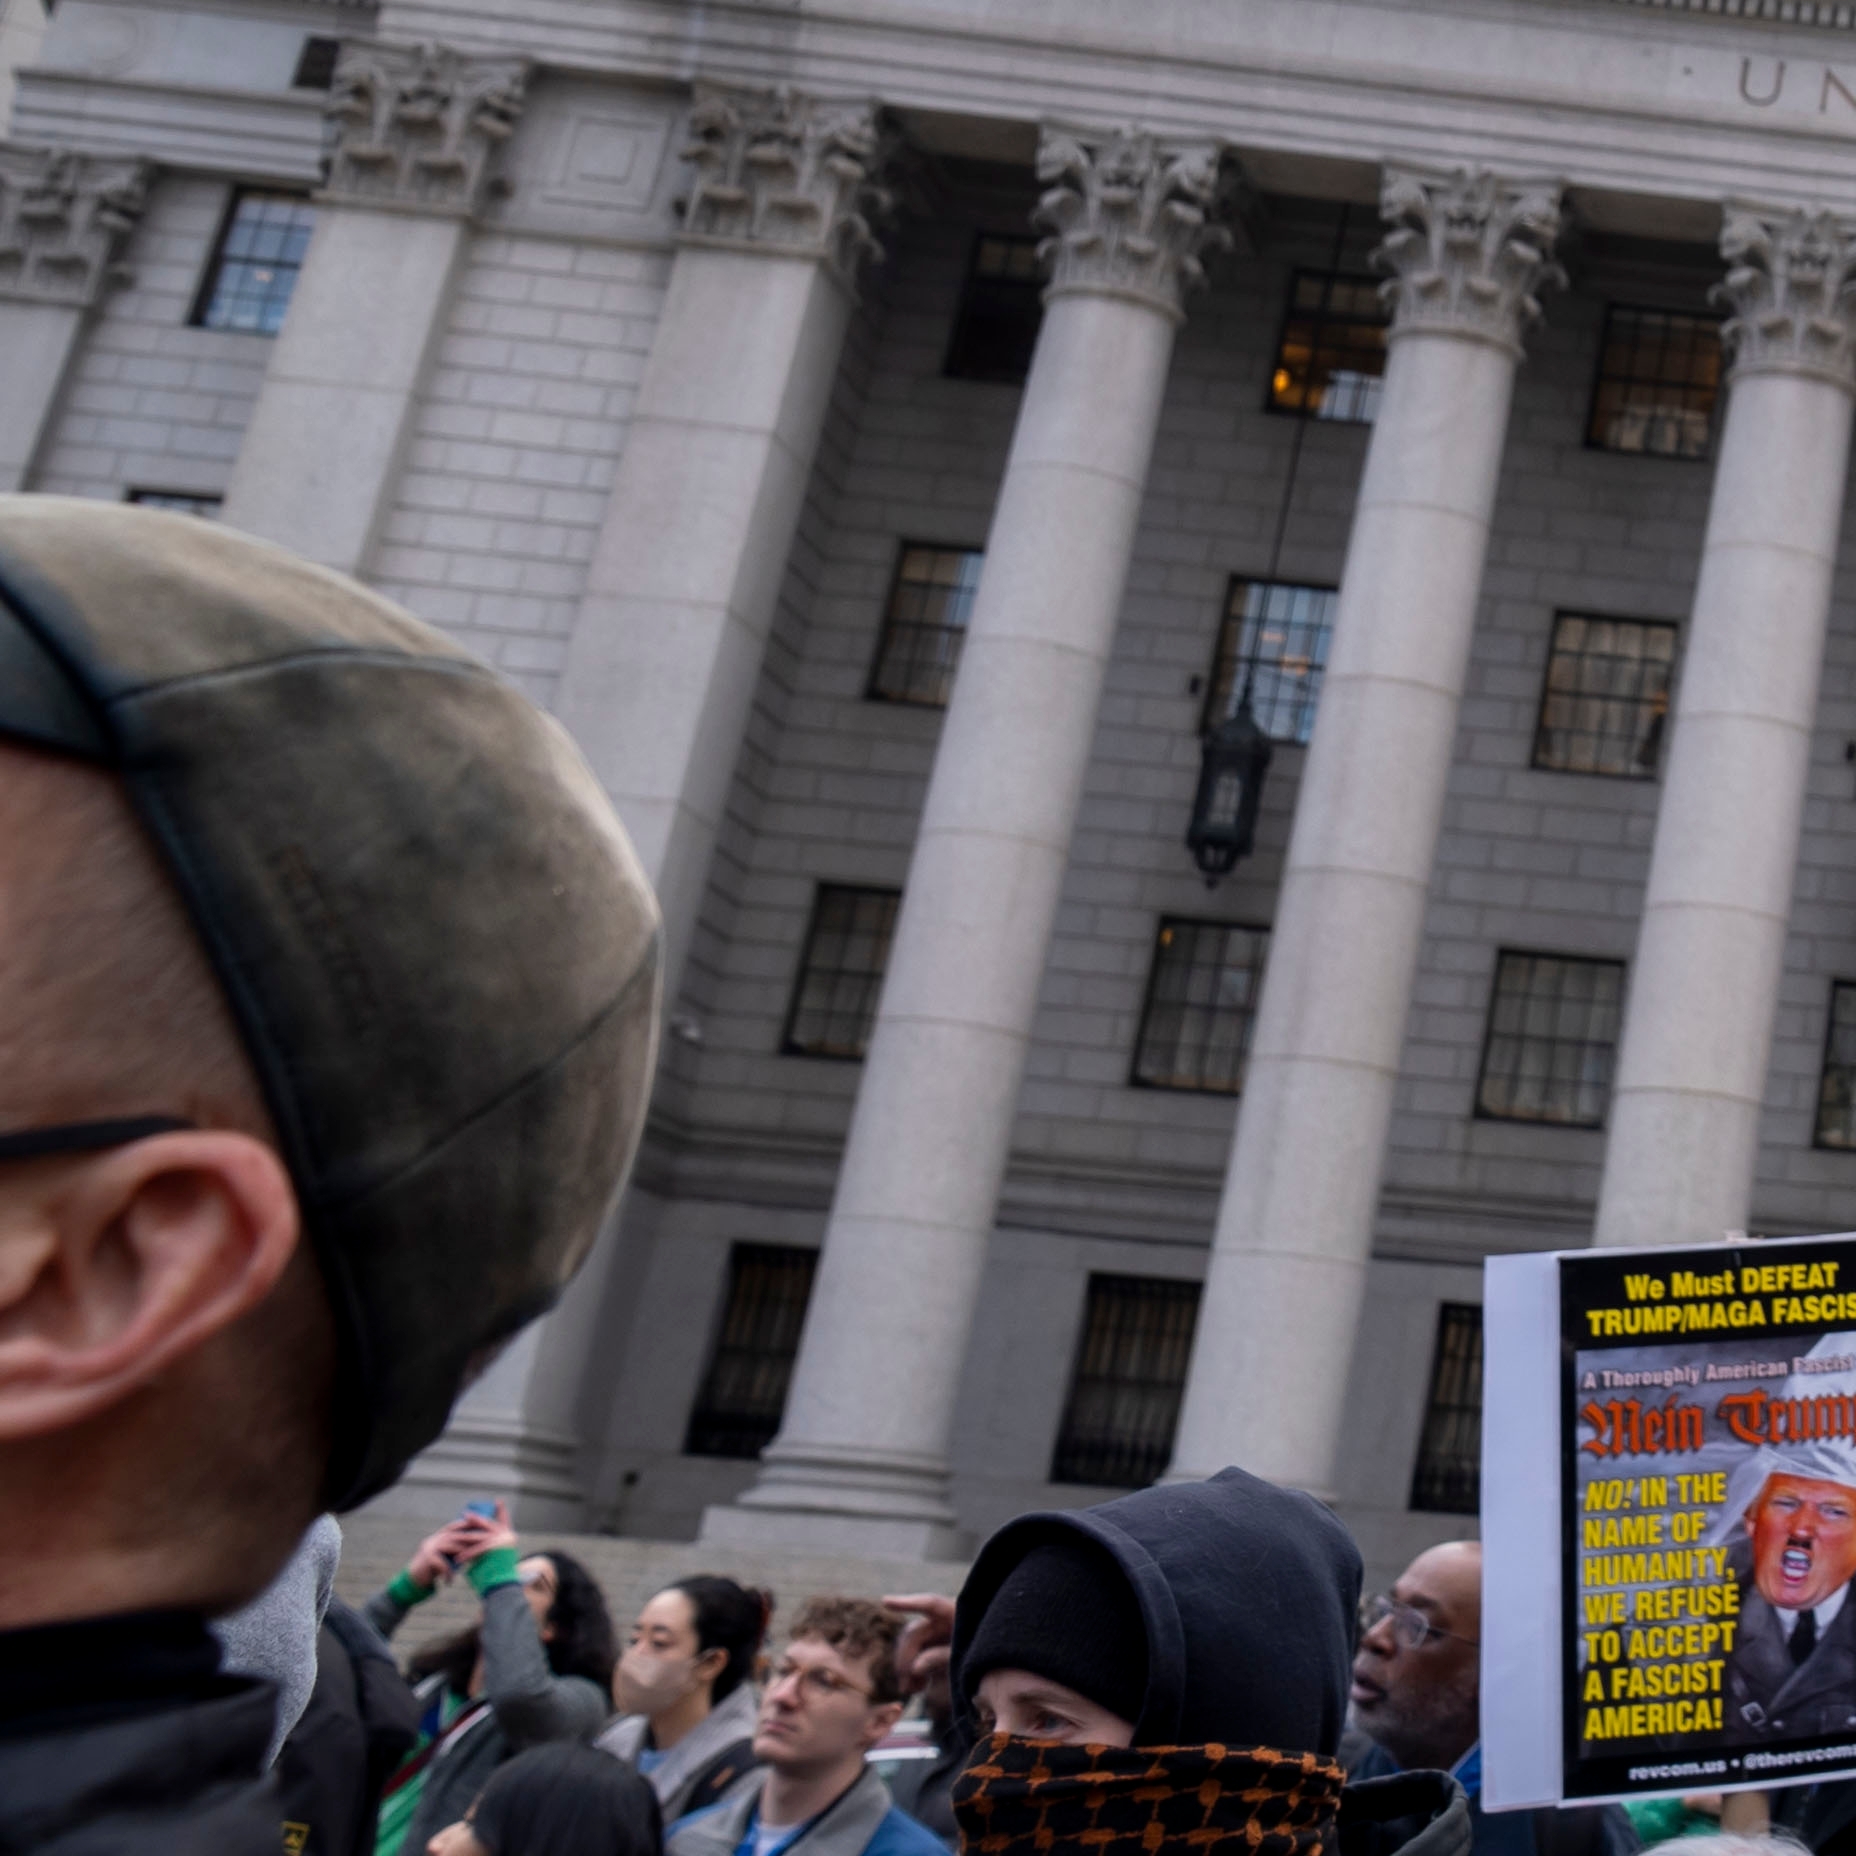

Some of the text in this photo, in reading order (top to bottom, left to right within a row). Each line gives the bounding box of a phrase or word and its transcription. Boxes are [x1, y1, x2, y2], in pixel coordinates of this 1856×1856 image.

[1624, 1262, 1839, 1301] We Must DEFEAT
[1586, 1301, 1767, 1336] TRUMP/MAGA
[1583, 1372, 1598, 1390] A
[1603, 1365, 1700, 1388] Thoroughly
[1705, 1359, 1788, 1381] American
[1792, 1355, 1853, 1374] Fascist
[1581, 1395, 1704, 1459] Mein
[1585, 1473, 1727, 1511] NO! IN THE
[1584, 1512, 1706, 1548] NAME OF
[1584, 1548, 1735, 1586] HUMANITY,
[1585, 1583, 1740, 1625] WE REFUSE
[1585, 1621, 1737, 1663] TO ACCEPT
[1584, 1660, 1725, 1702] A FASCIST
[1584, 1698, 1723, 1740] AMERICA!
[1628, 1760, 1728, 1781] revcom.us
